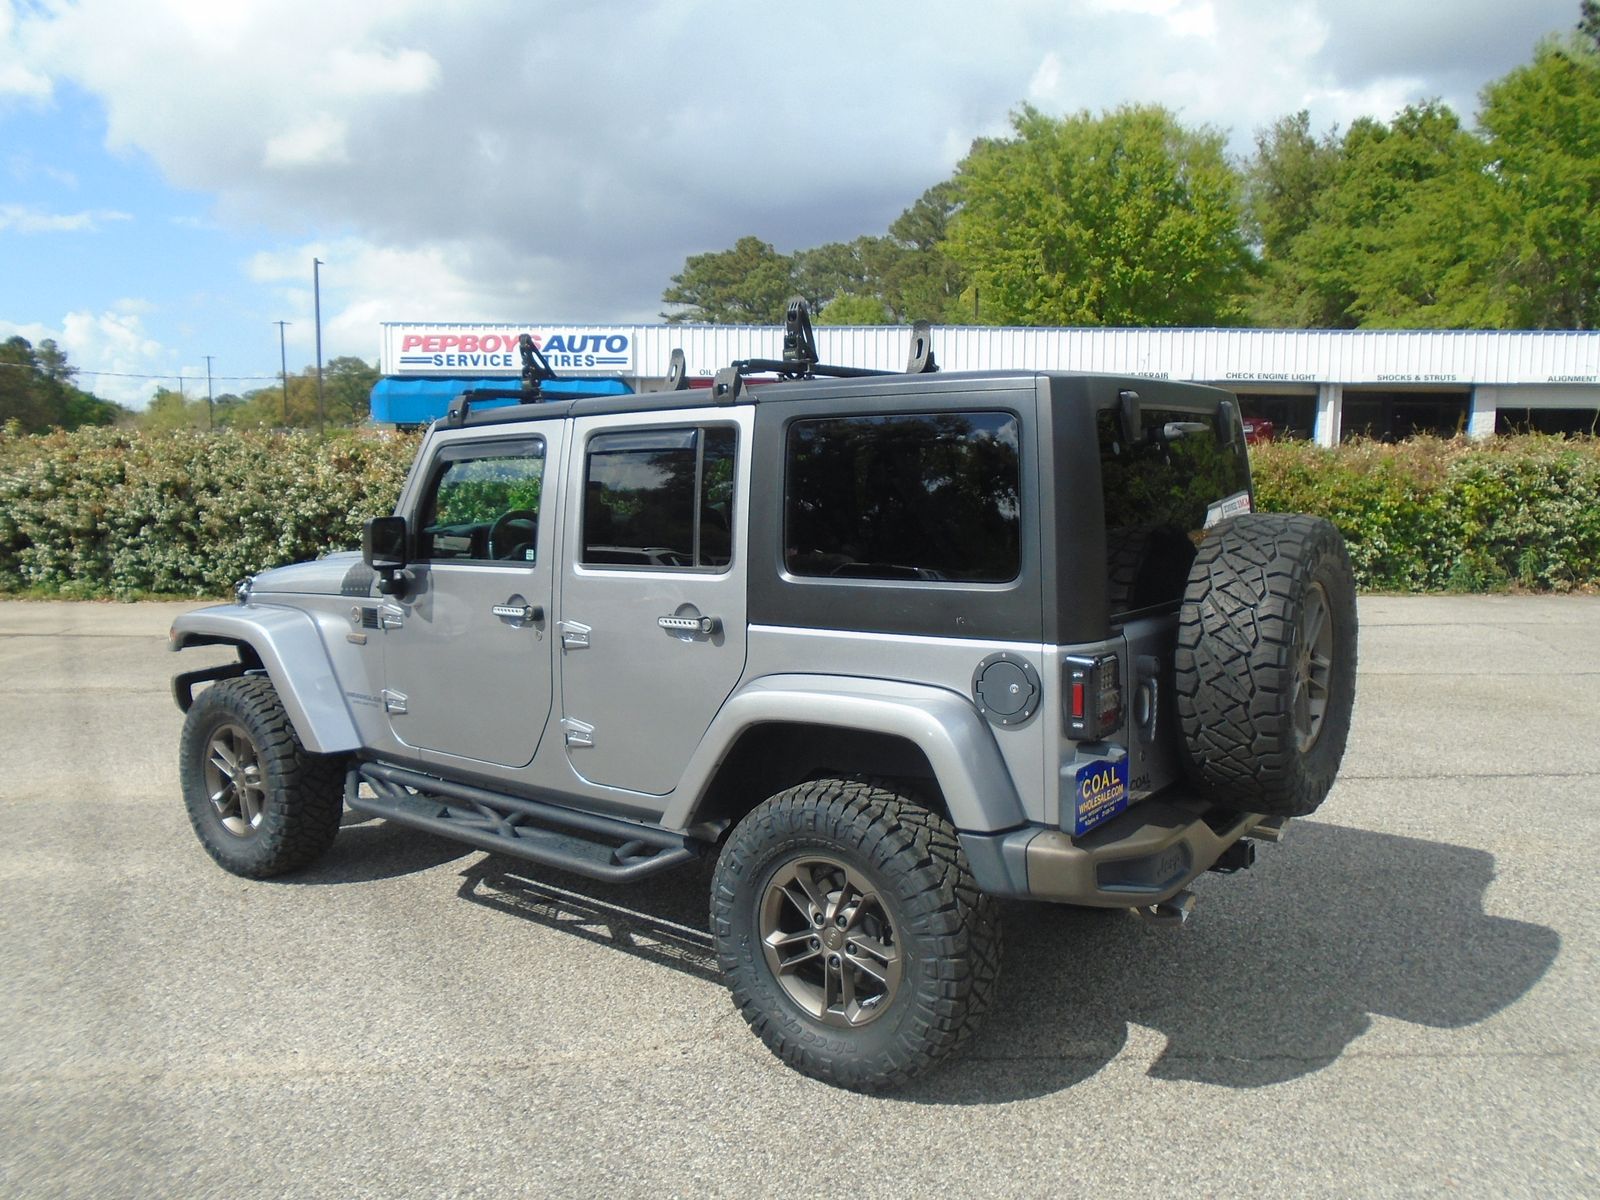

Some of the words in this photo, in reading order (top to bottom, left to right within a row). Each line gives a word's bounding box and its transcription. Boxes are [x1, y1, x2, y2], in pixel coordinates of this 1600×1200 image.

[542, 335, 628, 353] AUTO
[433, 355, 513, 367] SERVICE
[543, 355, 595, 367] TIRES
[1226, 372, 1254, 380] CHECK
[1291, 373, 1316, 381] LIGHT
[1082, 766, 1120, 798] COAL
